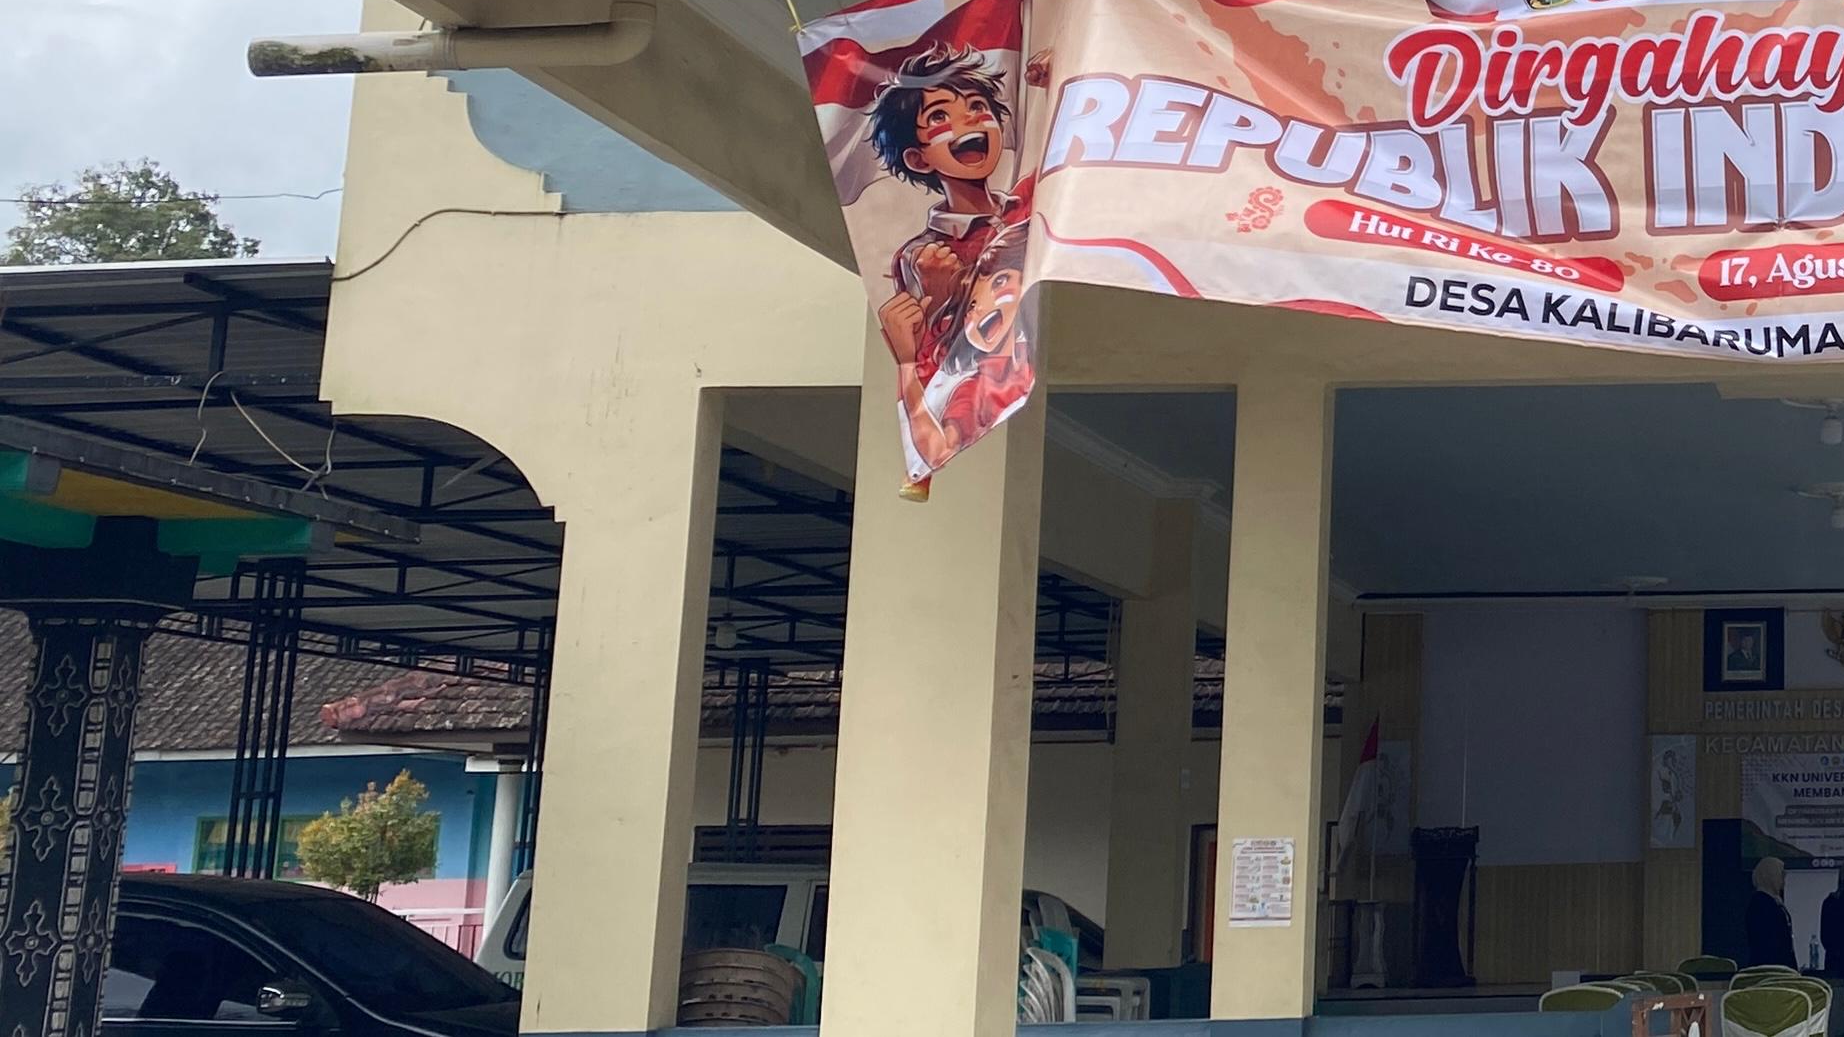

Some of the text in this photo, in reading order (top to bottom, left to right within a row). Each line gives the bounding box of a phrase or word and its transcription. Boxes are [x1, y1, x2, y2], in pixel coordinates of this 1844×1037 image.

[1042, 75, 1618, 241] REPUBLIK
[1348, 210, 1413, 239] Hut
[1421, 230, 1459, 253] Ri
[1719, 256, 1757, 289] 17,
[1404, 276, 1530, 321] DESA
[1704, 700, 1801, 721] PEMERINTAH
[1772, 772, 1799, 783] KKN
